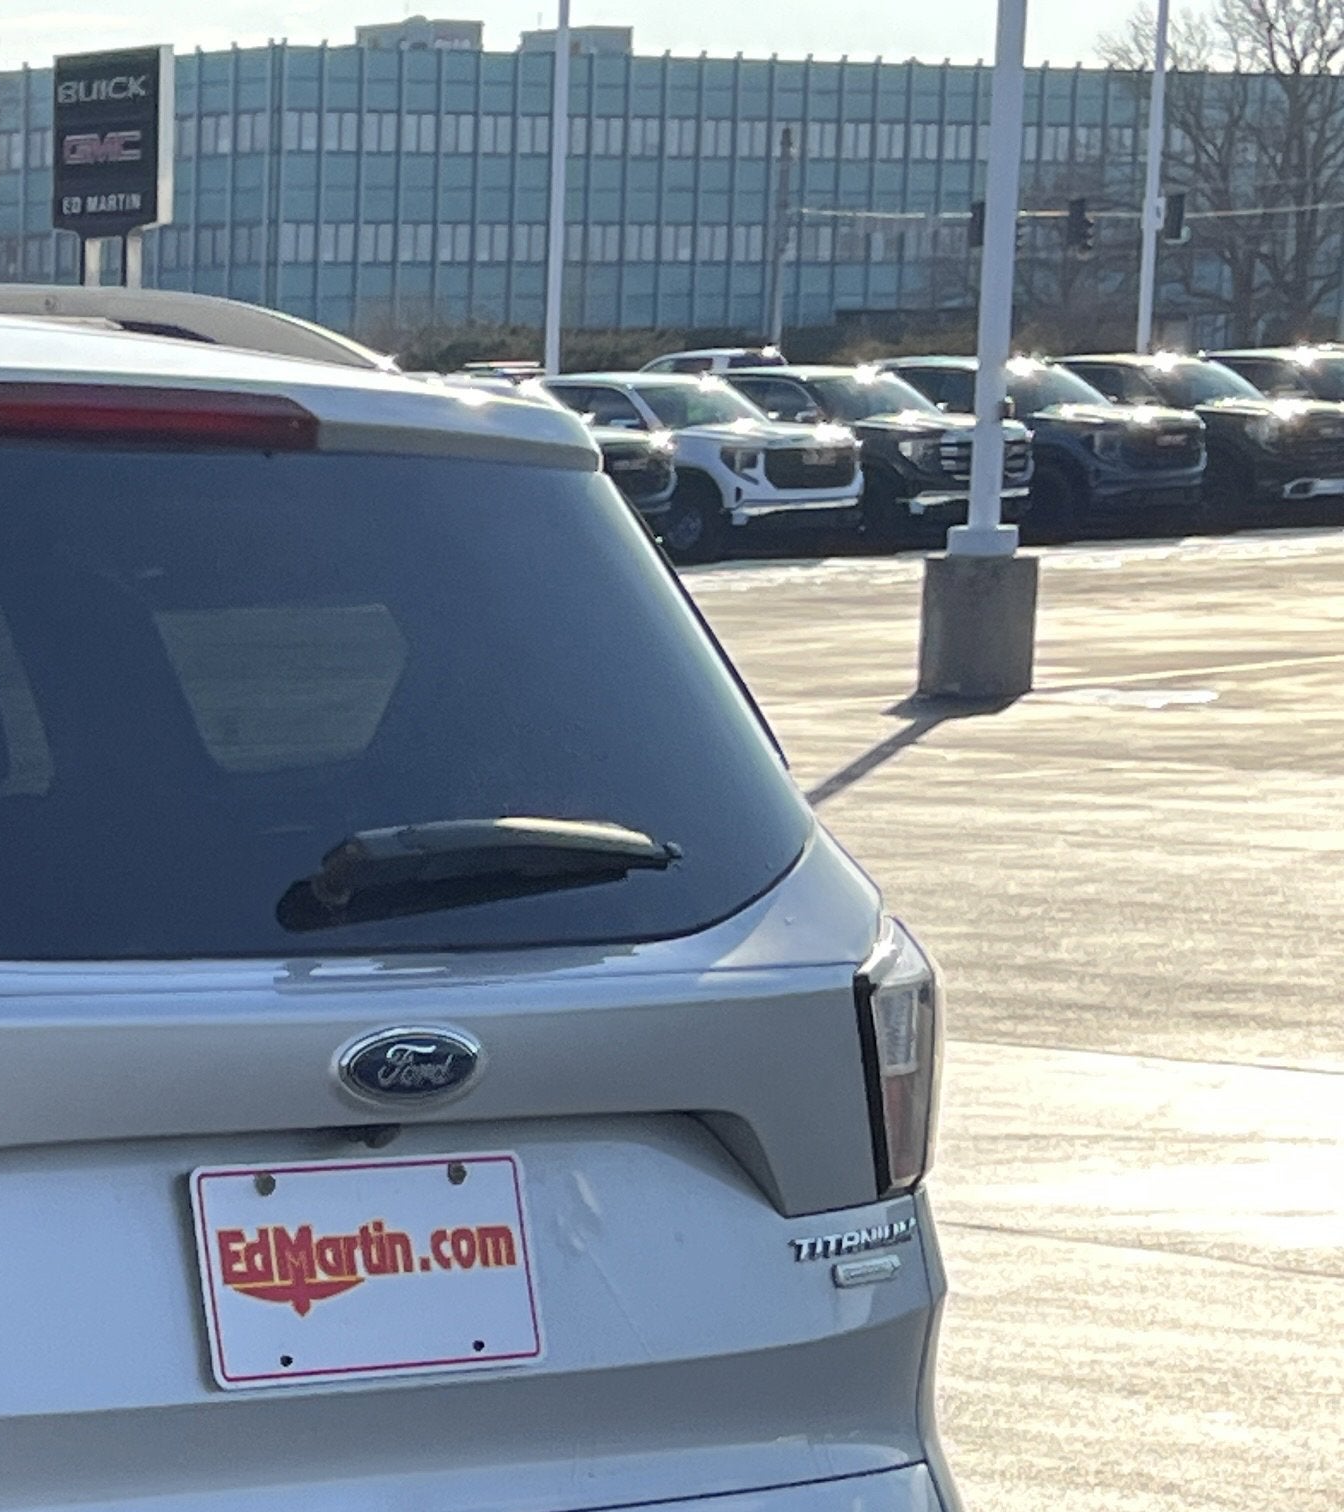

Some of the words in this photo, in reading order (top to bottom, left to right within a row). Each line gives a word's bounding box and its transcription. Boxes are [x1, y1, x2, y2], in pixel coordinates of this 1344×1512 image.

[58, 75, 147, 104] BUICK
[64, 130, 142, 165] GMC
[63, 196, 82, 215] ED
[86, 193, 141, 213] MARTIN
[378, 1043, 454, 1087] Ford
[217, 1219, 517, 1285] EdMartin.com
